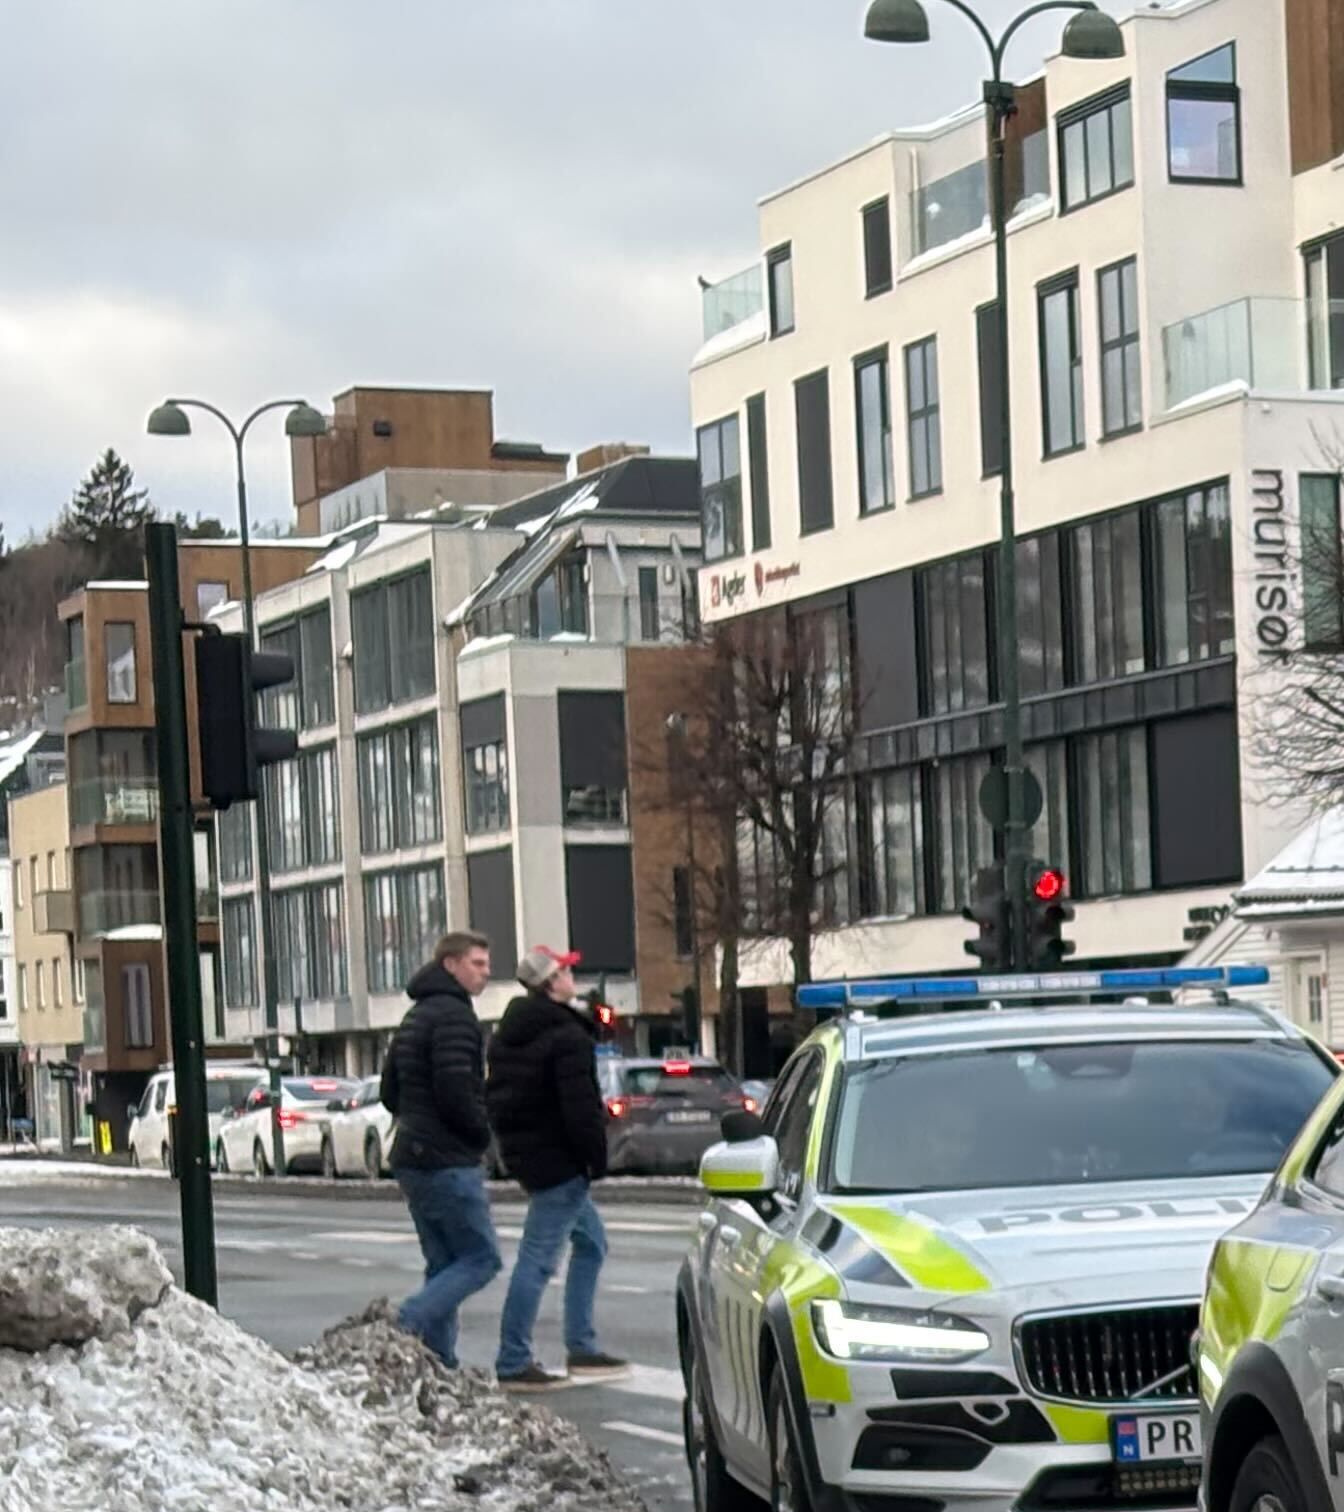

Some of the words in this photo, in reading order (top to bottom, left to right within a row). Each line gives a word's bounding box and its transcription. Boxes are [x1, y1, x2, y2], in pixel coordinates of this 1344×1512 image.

[1252, 469, 1298, 666] murisør
[977, 1198, 1262, 1234] POLI
[1123, 1444, 1134, 1456] N
[1147, 1420, 1194, 1455] PR
